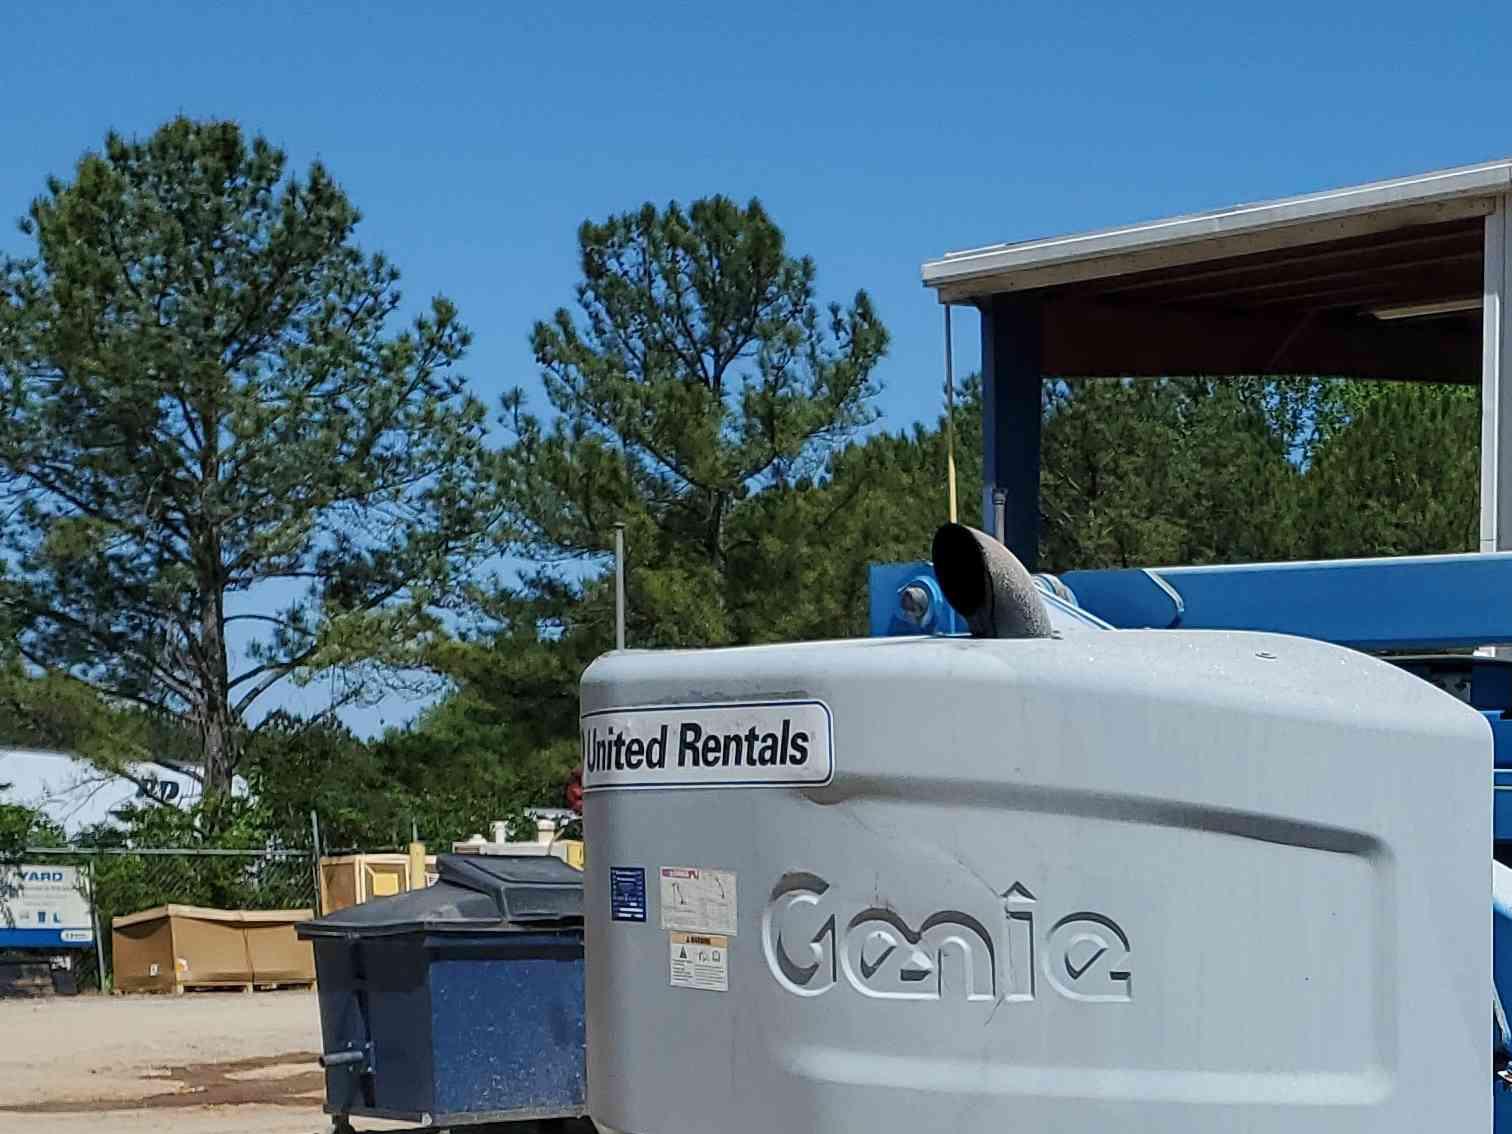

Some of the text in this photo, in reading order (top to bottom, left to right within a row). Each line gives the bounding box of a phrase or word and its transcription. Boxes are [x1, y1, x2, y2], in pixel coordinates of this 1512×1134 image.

[587, 719, 809, 773] United Rentals
[762, 872, 1132, 1001] Genie
